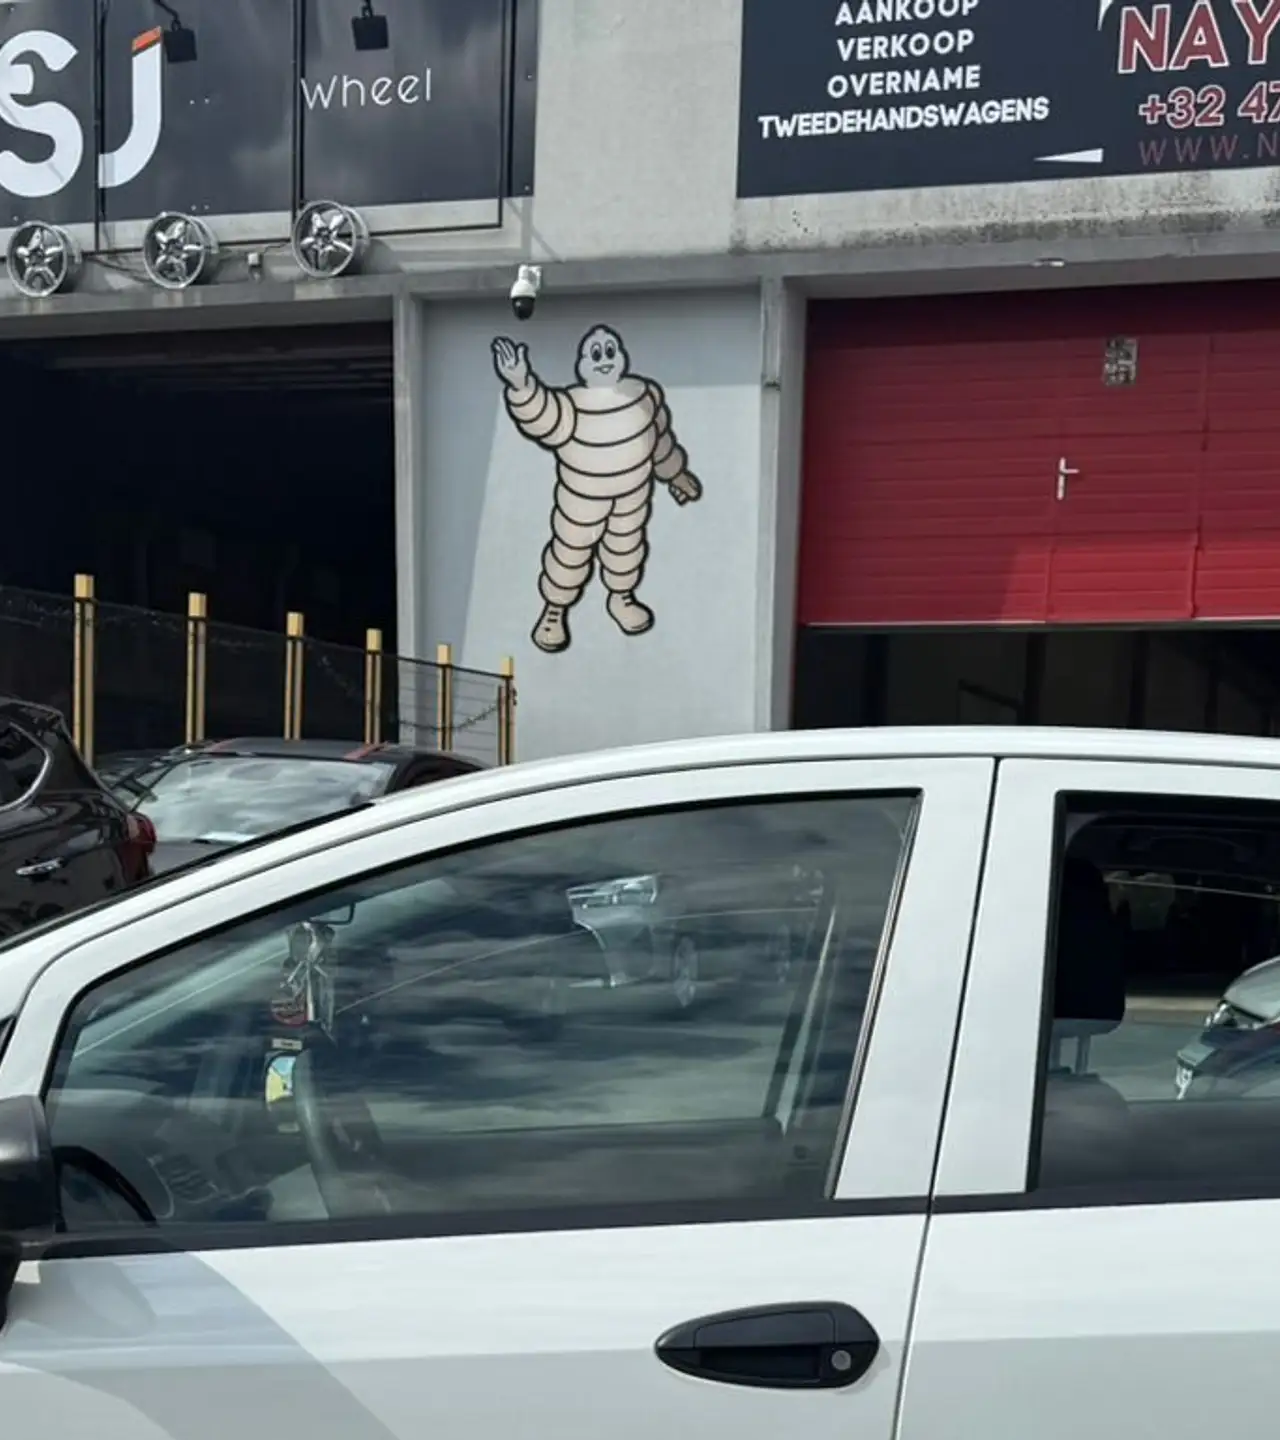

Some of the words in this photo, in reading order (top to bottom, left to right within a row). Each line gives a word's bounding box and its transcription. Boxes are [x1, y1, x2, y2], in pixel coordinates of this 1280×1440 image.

[834, 0, 979, 26] AANKOOP
[836, 29, 975, 62] VERKOOP
[827, 64, 981, 99] OVERNAME
[758, 96, 1050, 139] TWEEDEHANDSWAGENS
[1138, 84, 1227, 129] +32
